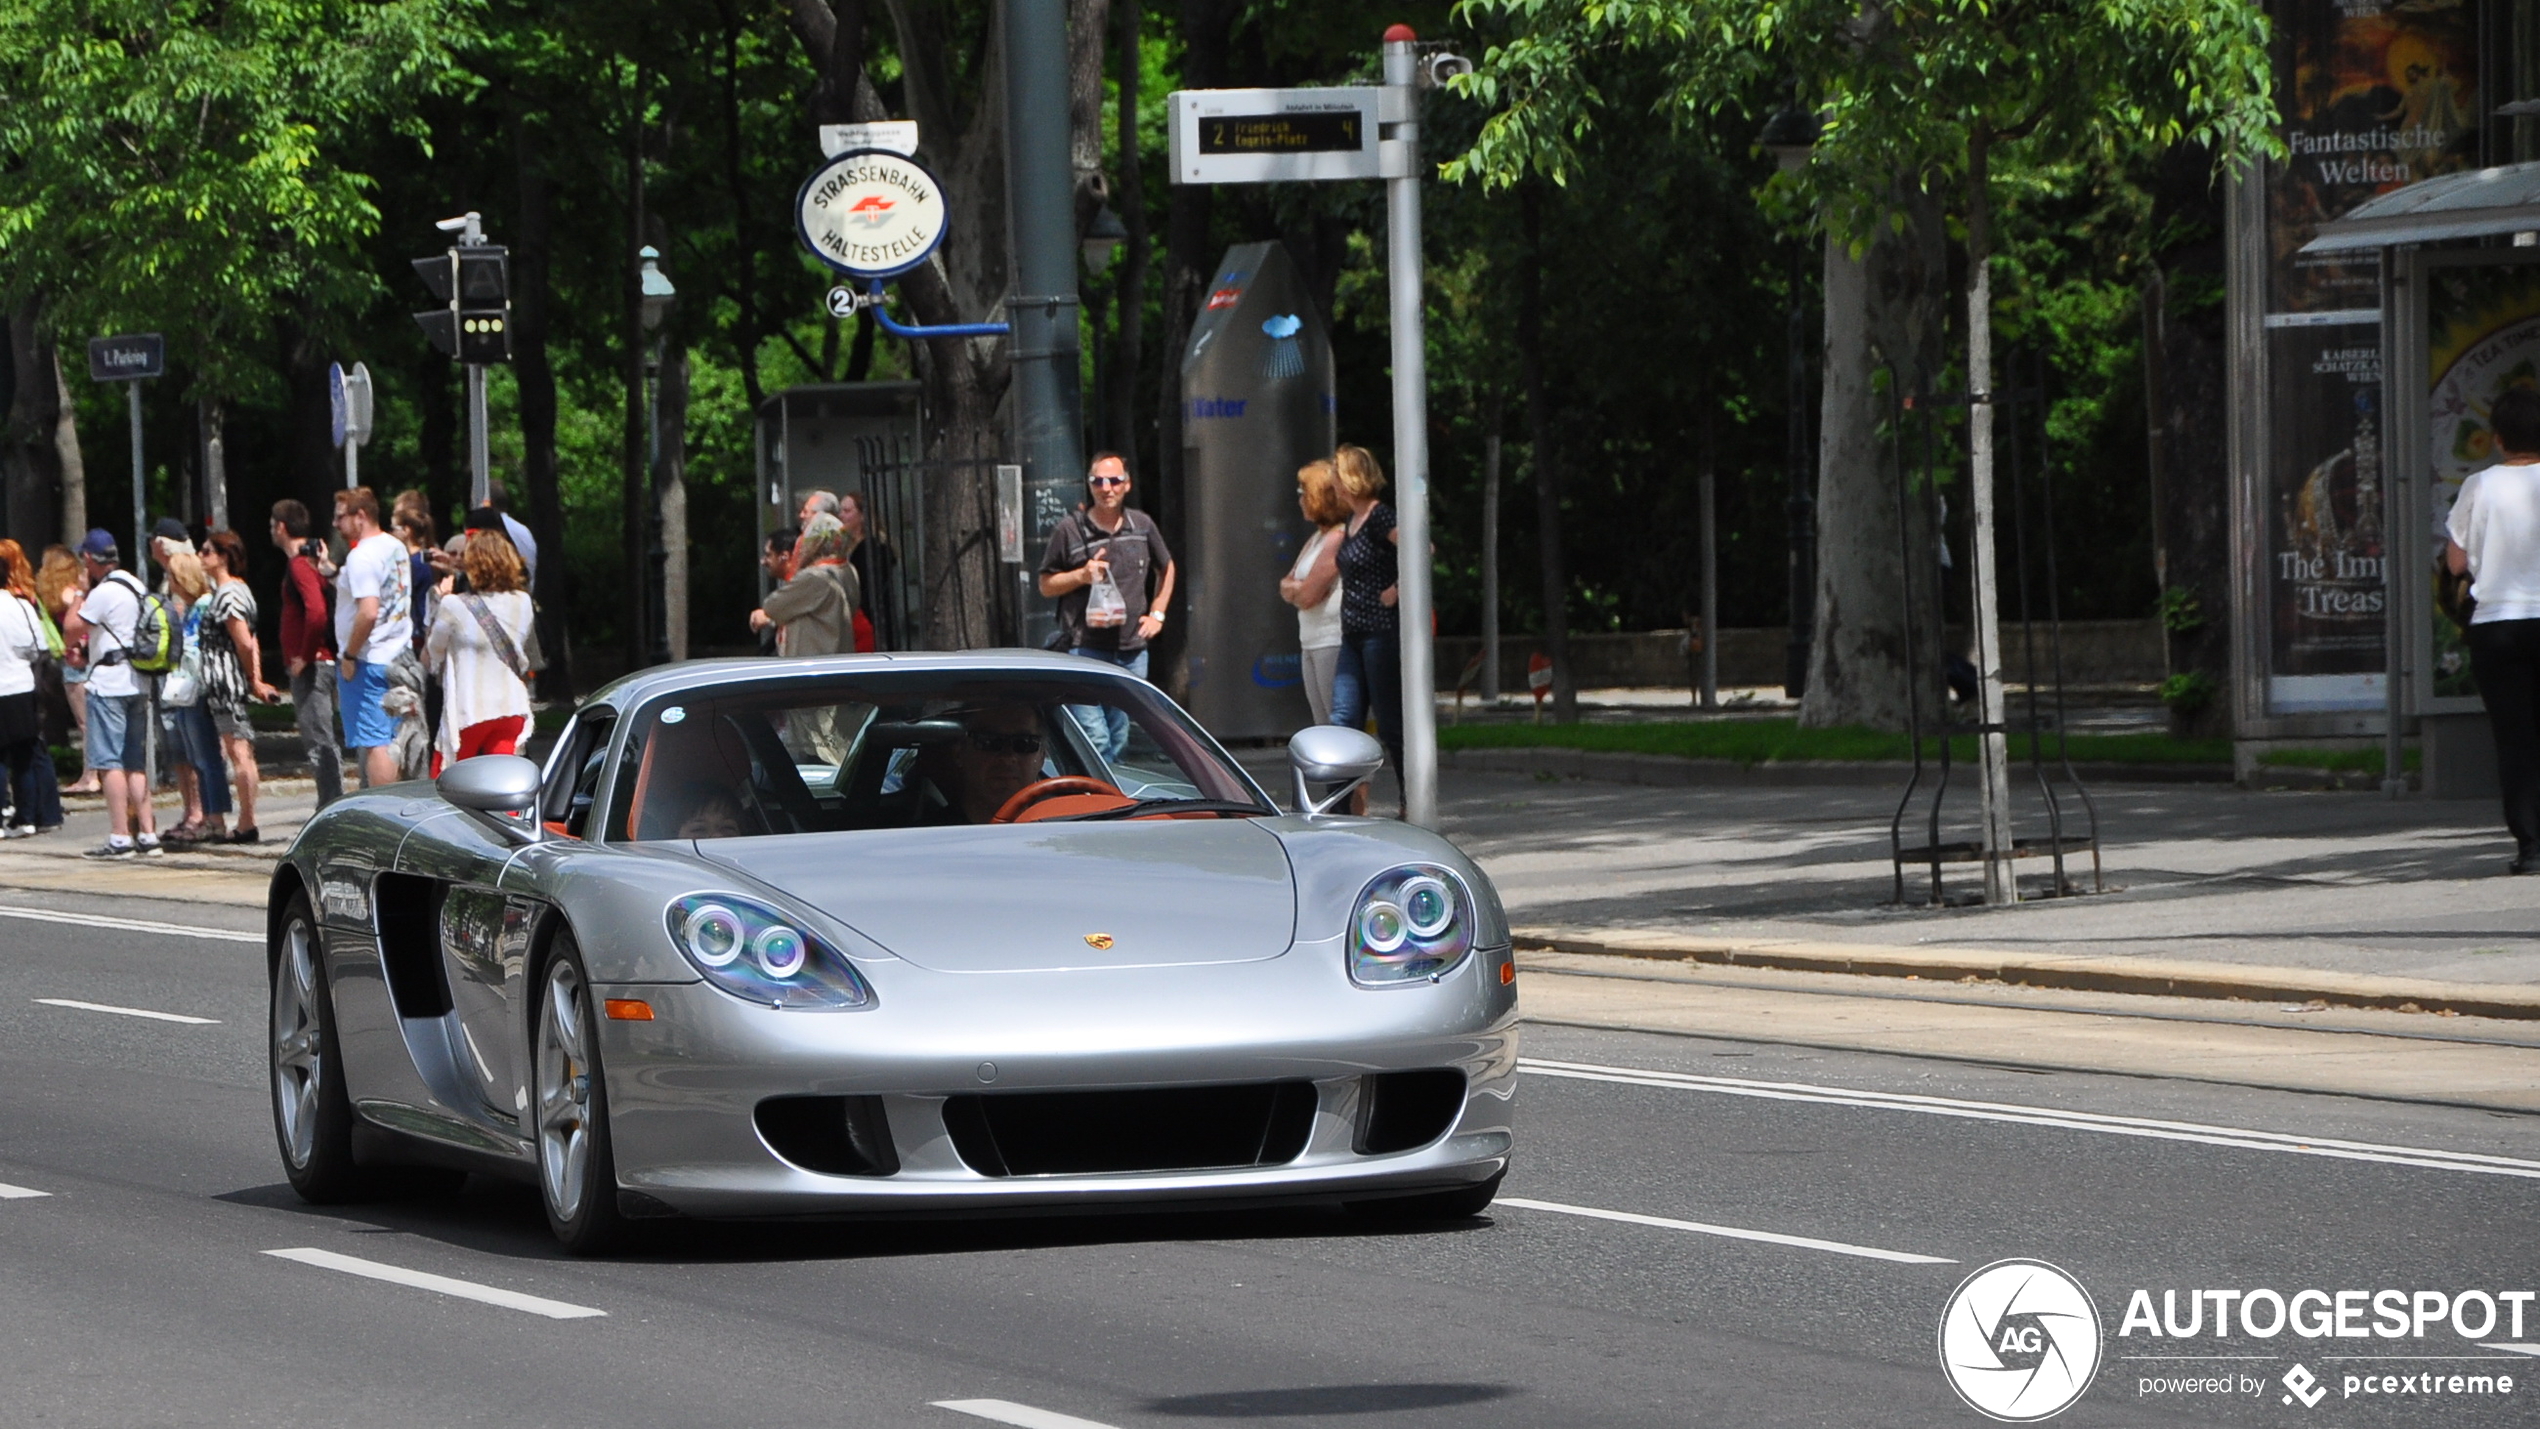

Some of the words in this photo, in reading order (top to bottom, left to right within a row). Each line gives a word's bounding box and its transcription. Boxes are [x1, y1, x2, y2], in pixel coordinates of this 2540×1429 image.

[1213, 122, 1225, 146] 2
[1234, 121, 1291, 134] Friedrich
[1342, 119, 1354, 141] 4
[2289, 123, 2446, 156] Fantastische
[2319, 158, 2411, 185] Welten
[814, 165, 930, 210] STRASSENBAHN
[820, 225, 927, 263] HALTESTELLE
[833, 291, 851, 314] 2
[2469, 341, 2504, 366] TEA
[2278, 550, 2325, 580] The
[2301, 585, 2384, 614] Treas
